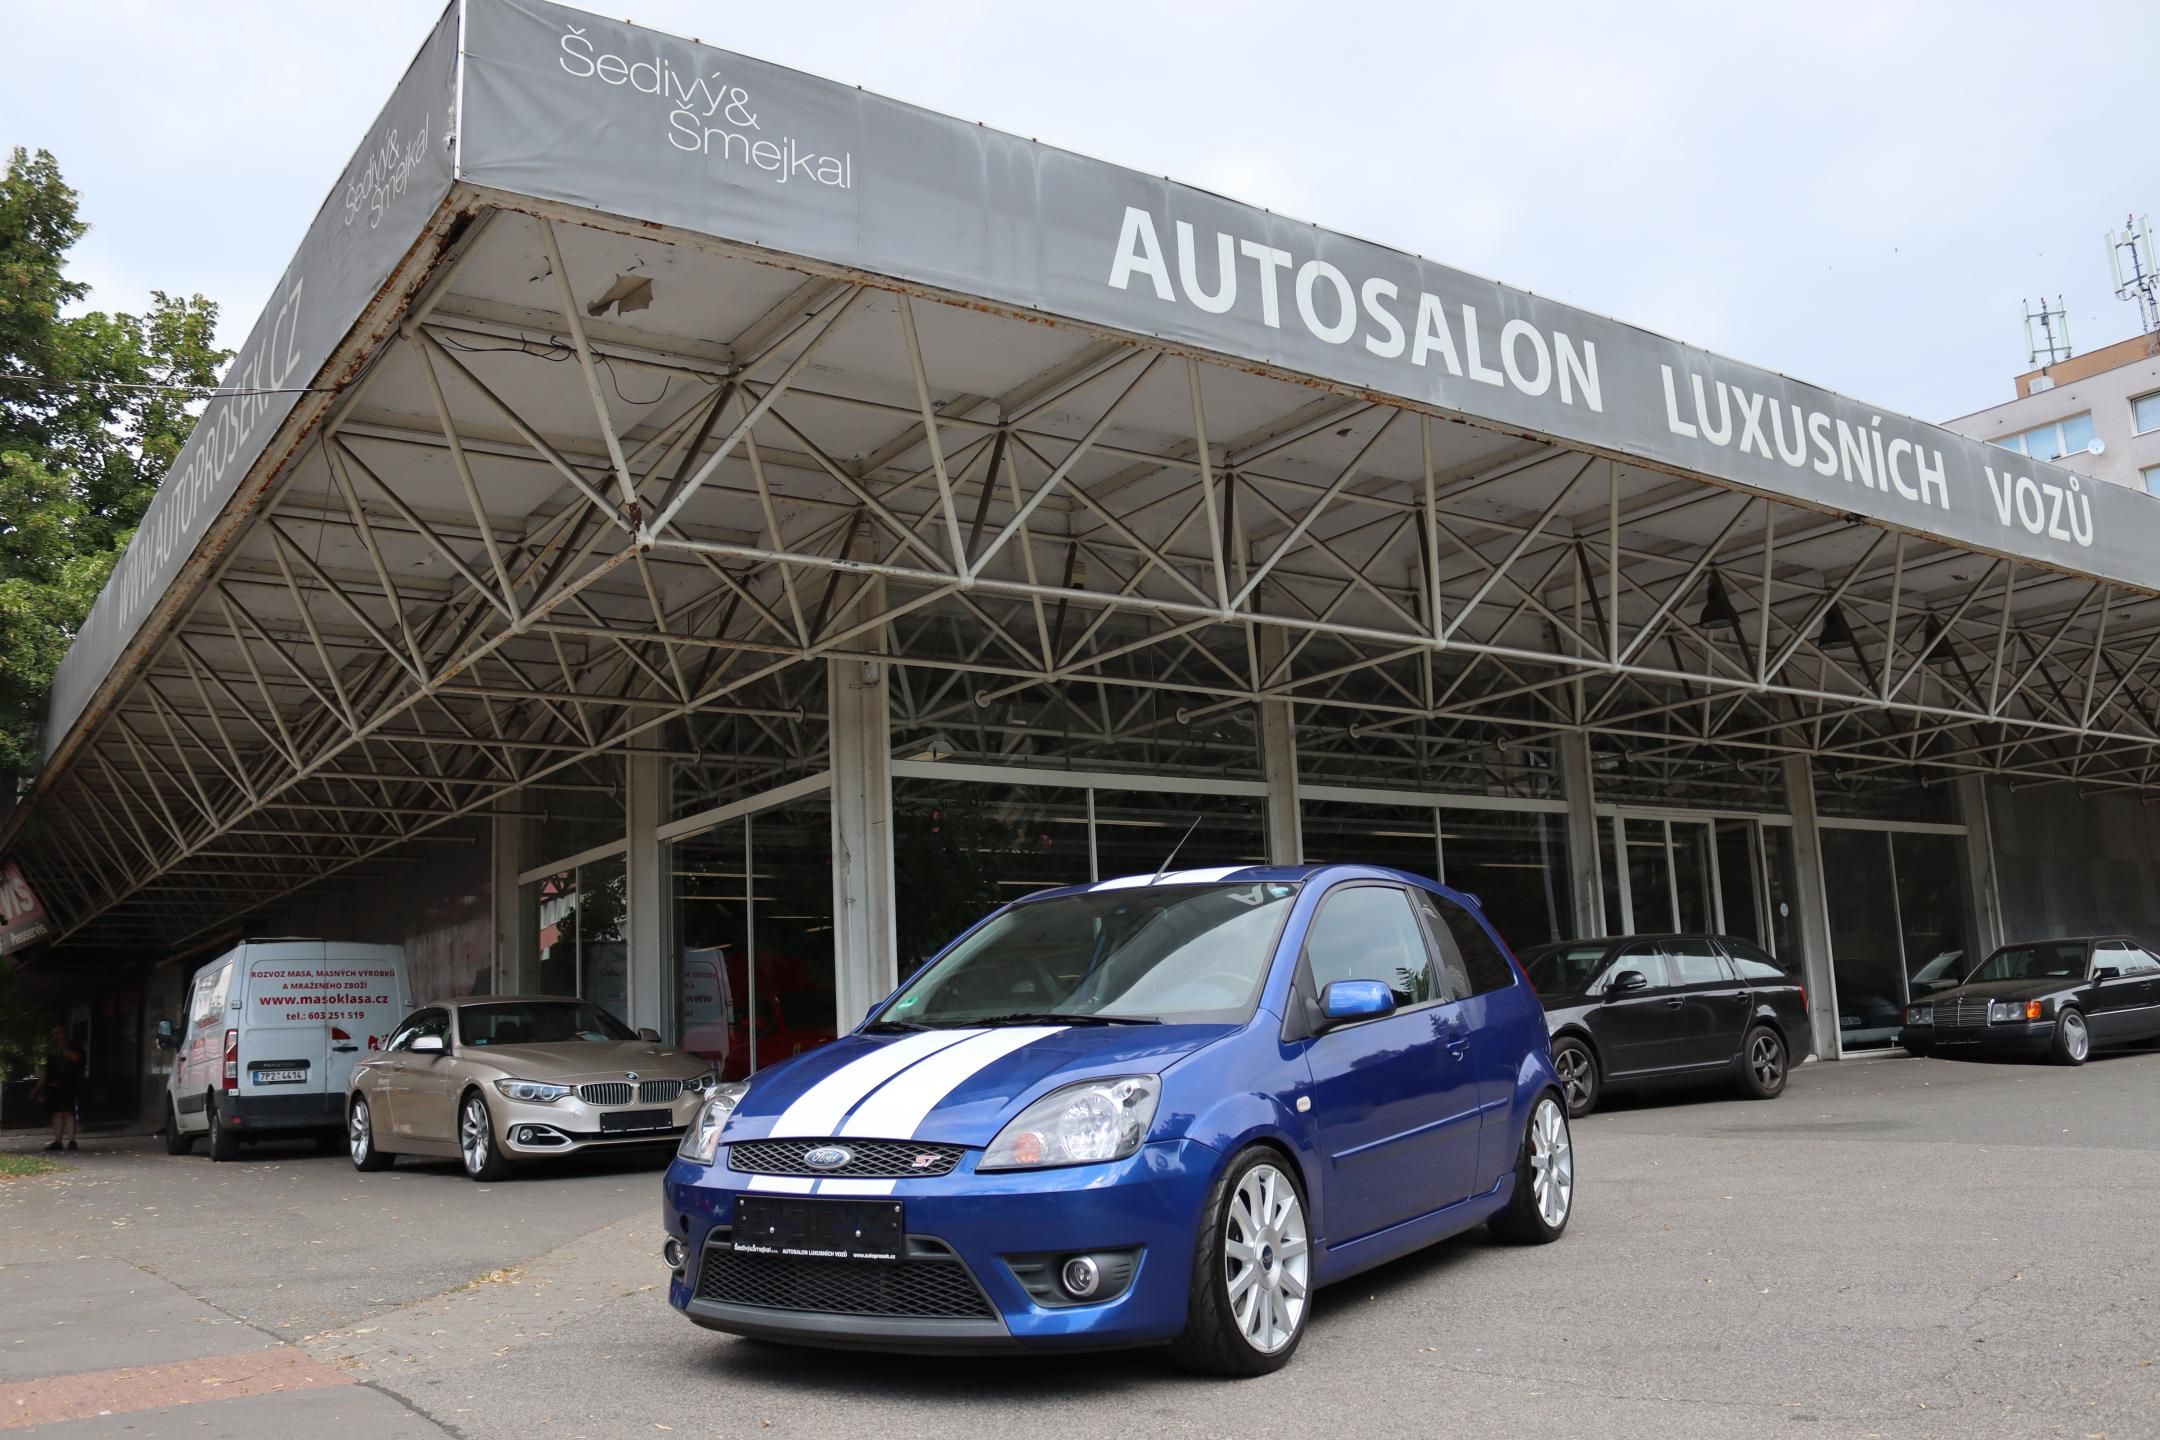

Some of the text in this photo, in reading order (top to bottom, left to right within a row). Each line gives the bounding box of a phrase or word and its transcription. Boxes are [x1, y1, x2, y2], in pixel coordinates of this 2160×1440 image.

[559, 23, 760, 130] Šedivý&
[370, 111, 430, 229] Šmejkal
[668, 99, 850, 189] Šmejkal
[1107, 205, 2095, 548] AUTOSALON LUXUSNÍCH VOZŮ
[117, 277, 304, 631] WWW.AUTOPROSEK.CZ
[251, 967, 396, 979] ROZVOZ MASA, MASNÝCH VÝROBKŮ
[290, 981, 342, 990] MRAŽENÉHO
[343, 980, 368, 989] ZBOŽÍ
[259, 993, 389, 1006] www.masoklasa.cz
[286, 1011, 365, 1021] tel.: 603 251 519
[911, 1154, 942, 1168] ST
